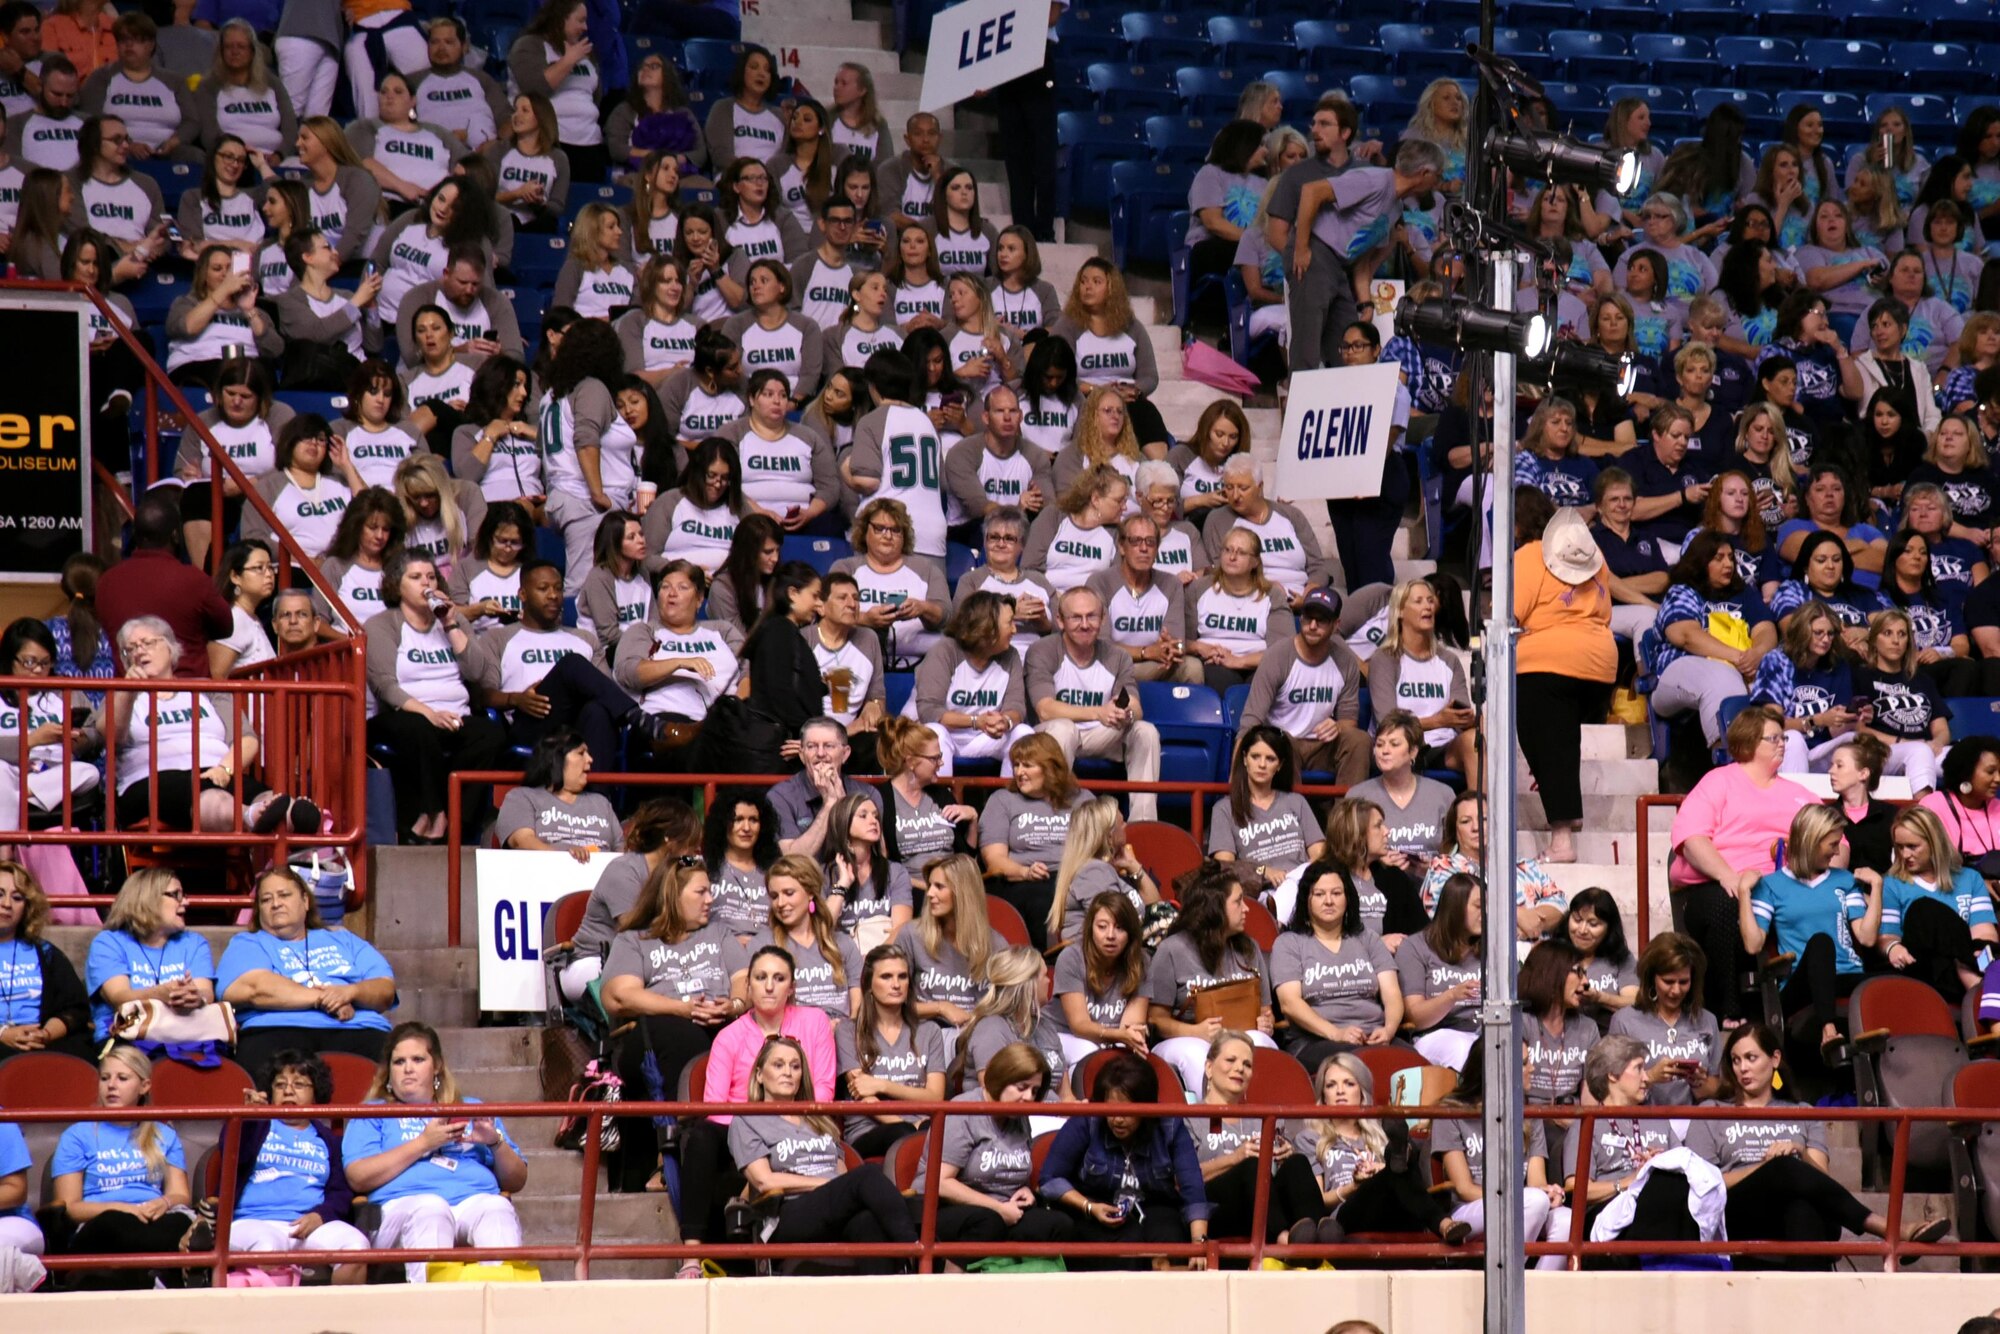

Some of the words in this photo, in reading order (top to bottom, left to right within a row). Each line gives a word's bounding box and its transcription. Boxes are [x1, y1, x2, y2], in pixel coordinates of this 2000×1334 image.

[959, 10, 1016, 70] LEE
[781, 48, 800, 68] 14
[111, 94, 163, 107] GLENN
[427, 89, 472, 101] GLENN
[224, 100, 273, 115] GLENN
[734, 125, 776, 142] GLENN
[385, 140, 434, 161] GLENN
[90, 203, 134, 220] GLENN
[394, 244, 431, 266] GLENN
[939, 250, 984, 265] GLENN
[748, 348, 795, 364] GLENN
[1080, 351, 1129, 369] GLENN
[0, 413, 76, 450] er
[1297, 405, 1373, 461] GLENN
[354, 445, 404, 458] GLENN
[748, 456, 801, 472] GLENN
[890, 434, 939, 489] 50
[297, 496, 347, 518] GLENN
[21, 516, 55, 530] 1260
[59, 517, 83, 530] AM
[682, 520, 734, 541] GLENN
[1054, 541, 1102, 560] GLENN
[1259, 537, 1294, 553] LENN
[1153, 549, 1188, 565] LENN
[1115, 615, 1163, 633] GLENN
[1205, 613, 1258, 633] GLENN
[662, 640, 716, 653] GLENN
[408, 649, 457, 664] GLENN
[951, 690, 998, 707] GLENN
[1056, 688, 1103, 707] GLENN
[1288, 685, 1333, 704] GLENN
[1399, 681, 1445, 700] GLENN
[1887, 694, 1924, 711] PIP
[541, 806, 609, 828] glenmore
[1239, 813, 1299, 846] glenmor
[1388, 823, 1437, 841] nmore
[1612, 841, 1619, 864] 1
[650, 942, 718, 969] glenmore
[1305, 958, 1374, 985] glenmor
[1646, 1039, 1707, 1063] lenmore
[1725, 1122, 1800, 1144] glenmore
[981, 1149, 1031, 1172] glenmor
